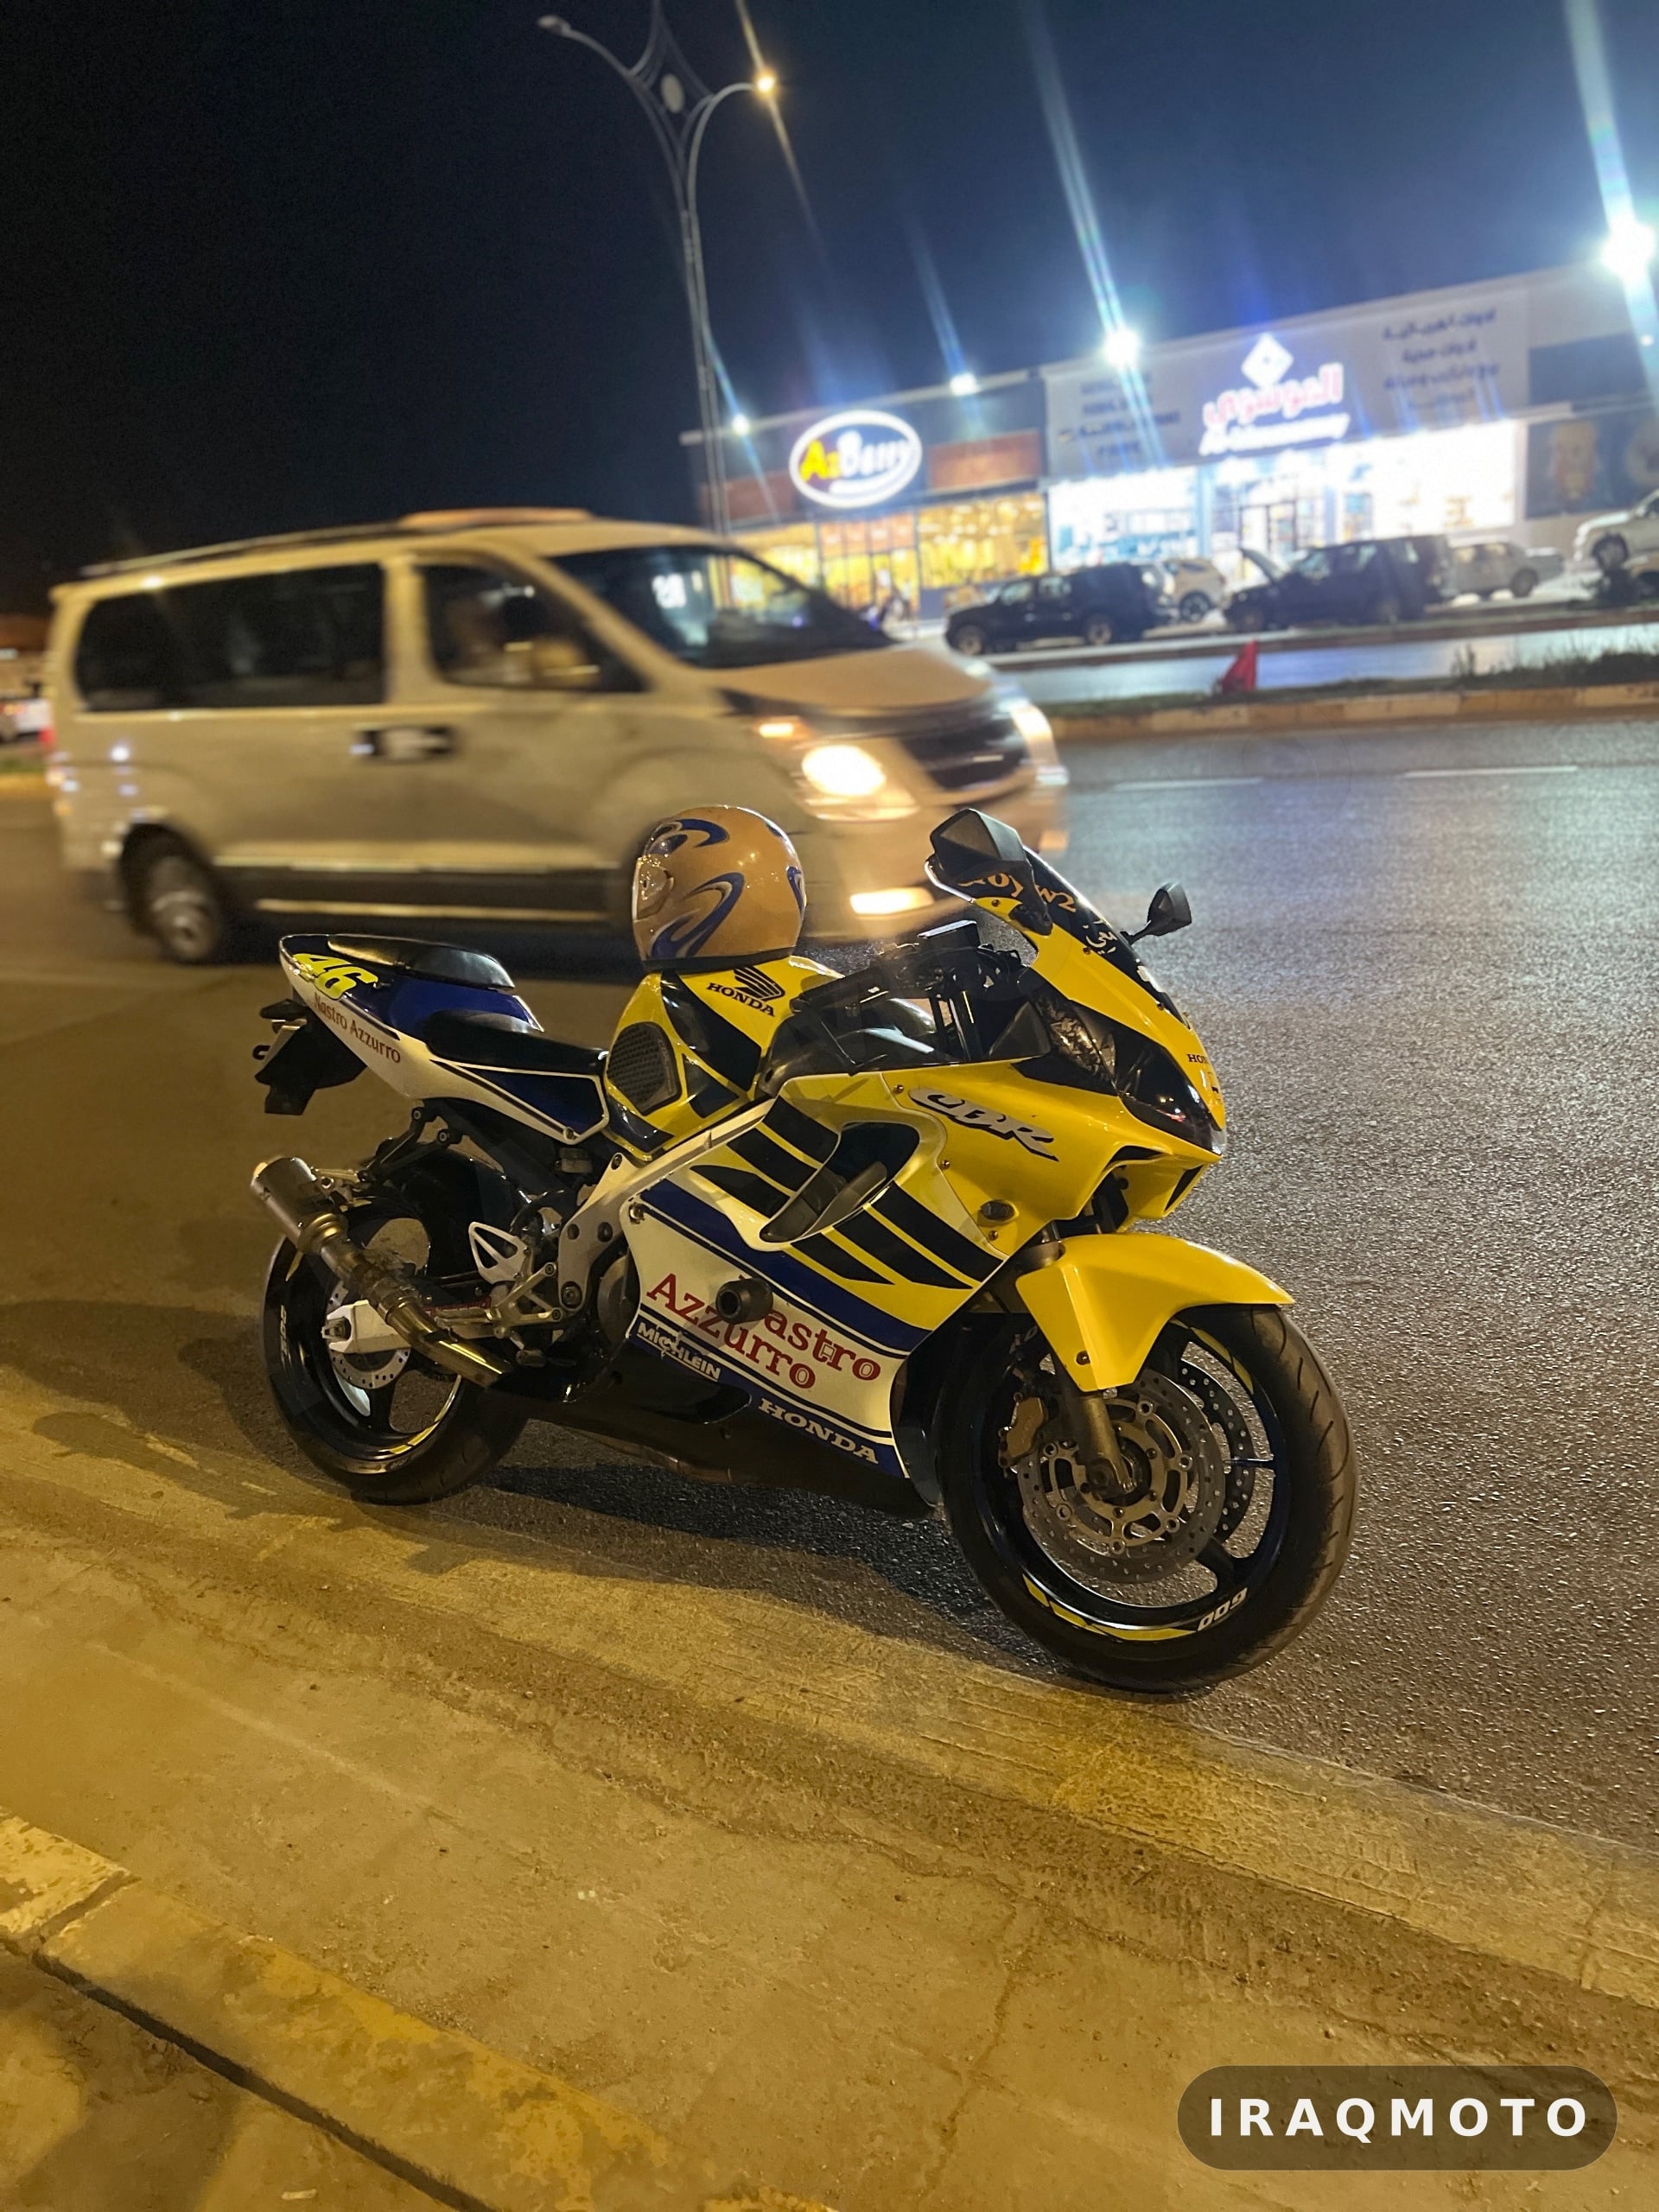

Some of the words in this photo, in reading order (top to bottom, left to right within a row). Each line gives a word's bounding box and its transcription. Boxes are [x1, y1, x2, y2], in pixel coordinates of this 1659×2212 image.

[292, 953, 378, 1000] 46
[707, 982, 775, 1017] HONDA
[314, 992, 347, 1030] Nastro
[350, 1020, 401, 1063] Azzurro
[908, 1084, 1059, 1162] CBR
[646, 1273, 816, 1389] Azzurro
[739, 1274, 881, 1381] astro
[758, 1397, 878, 1465] HONDA
